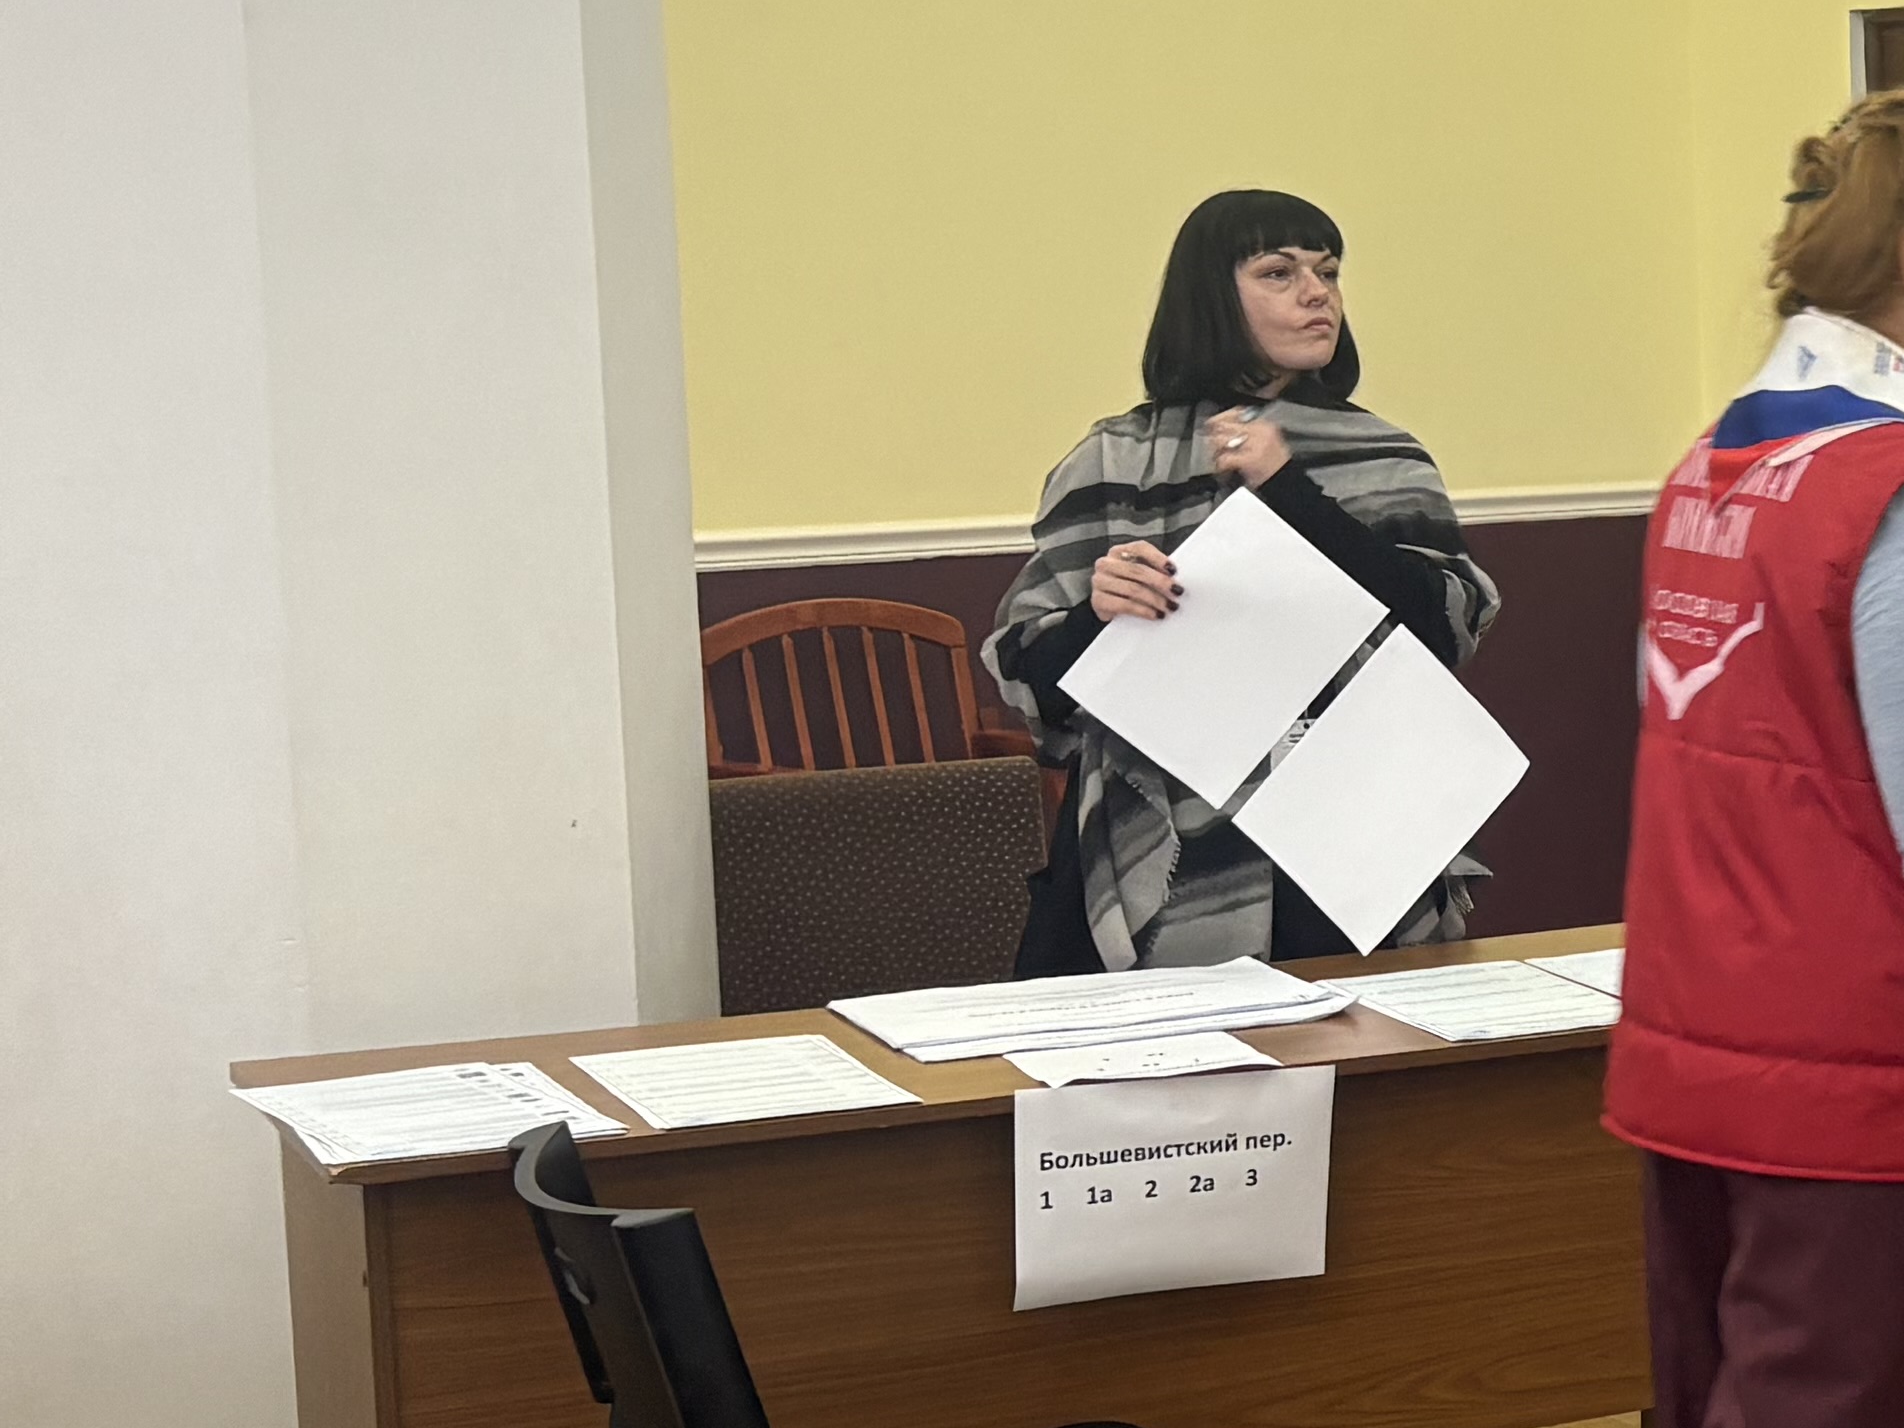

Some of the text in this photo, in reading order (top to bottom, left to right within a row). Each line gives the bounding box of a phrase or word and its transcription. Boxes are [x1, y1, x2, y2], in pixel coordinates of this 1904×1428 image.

[1039, 1131, 1293, 1171] Большевистский пер.
[1039, 1169, 1258, 1210] 1 1а 2 2а 3
